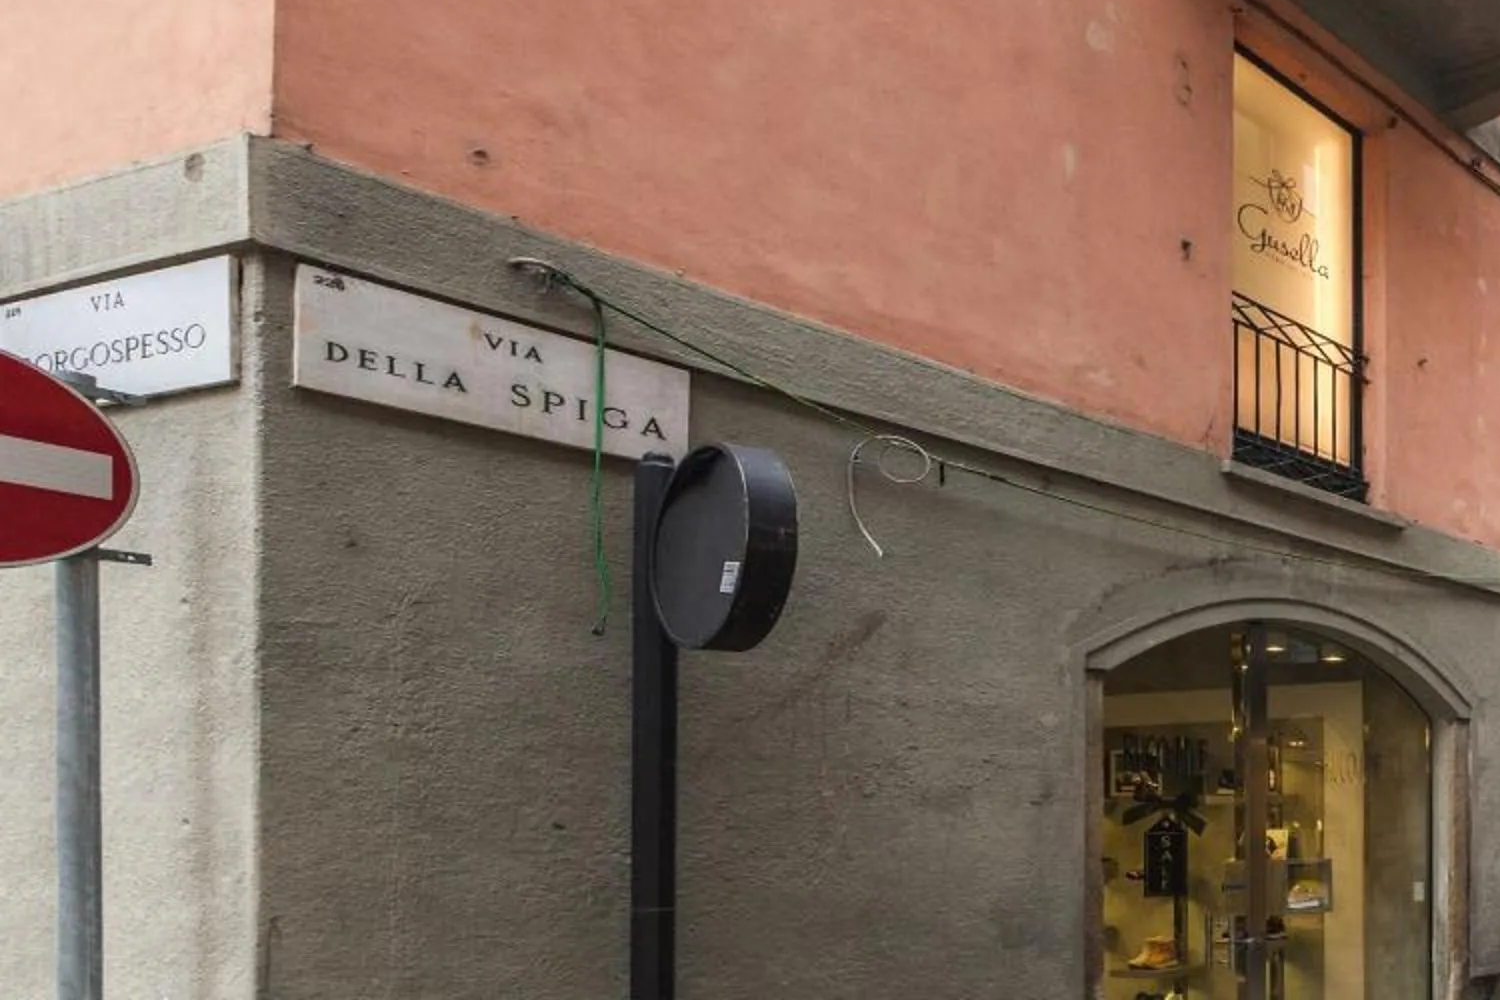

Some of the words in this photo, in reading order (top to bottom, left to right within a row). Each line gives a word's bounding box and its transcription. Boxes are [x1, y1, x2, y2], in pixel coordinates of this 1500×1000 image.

[1237, 203, 1329, 279] Gusella
[90, 291, 125, 313] VIA
[25, 323, 207, 372] ORGOSPESSO
[323, 341, 469, 394] DELLA
[483, 333, 544, 364] VIA
[510, 383, 667, 441] SPIGA
